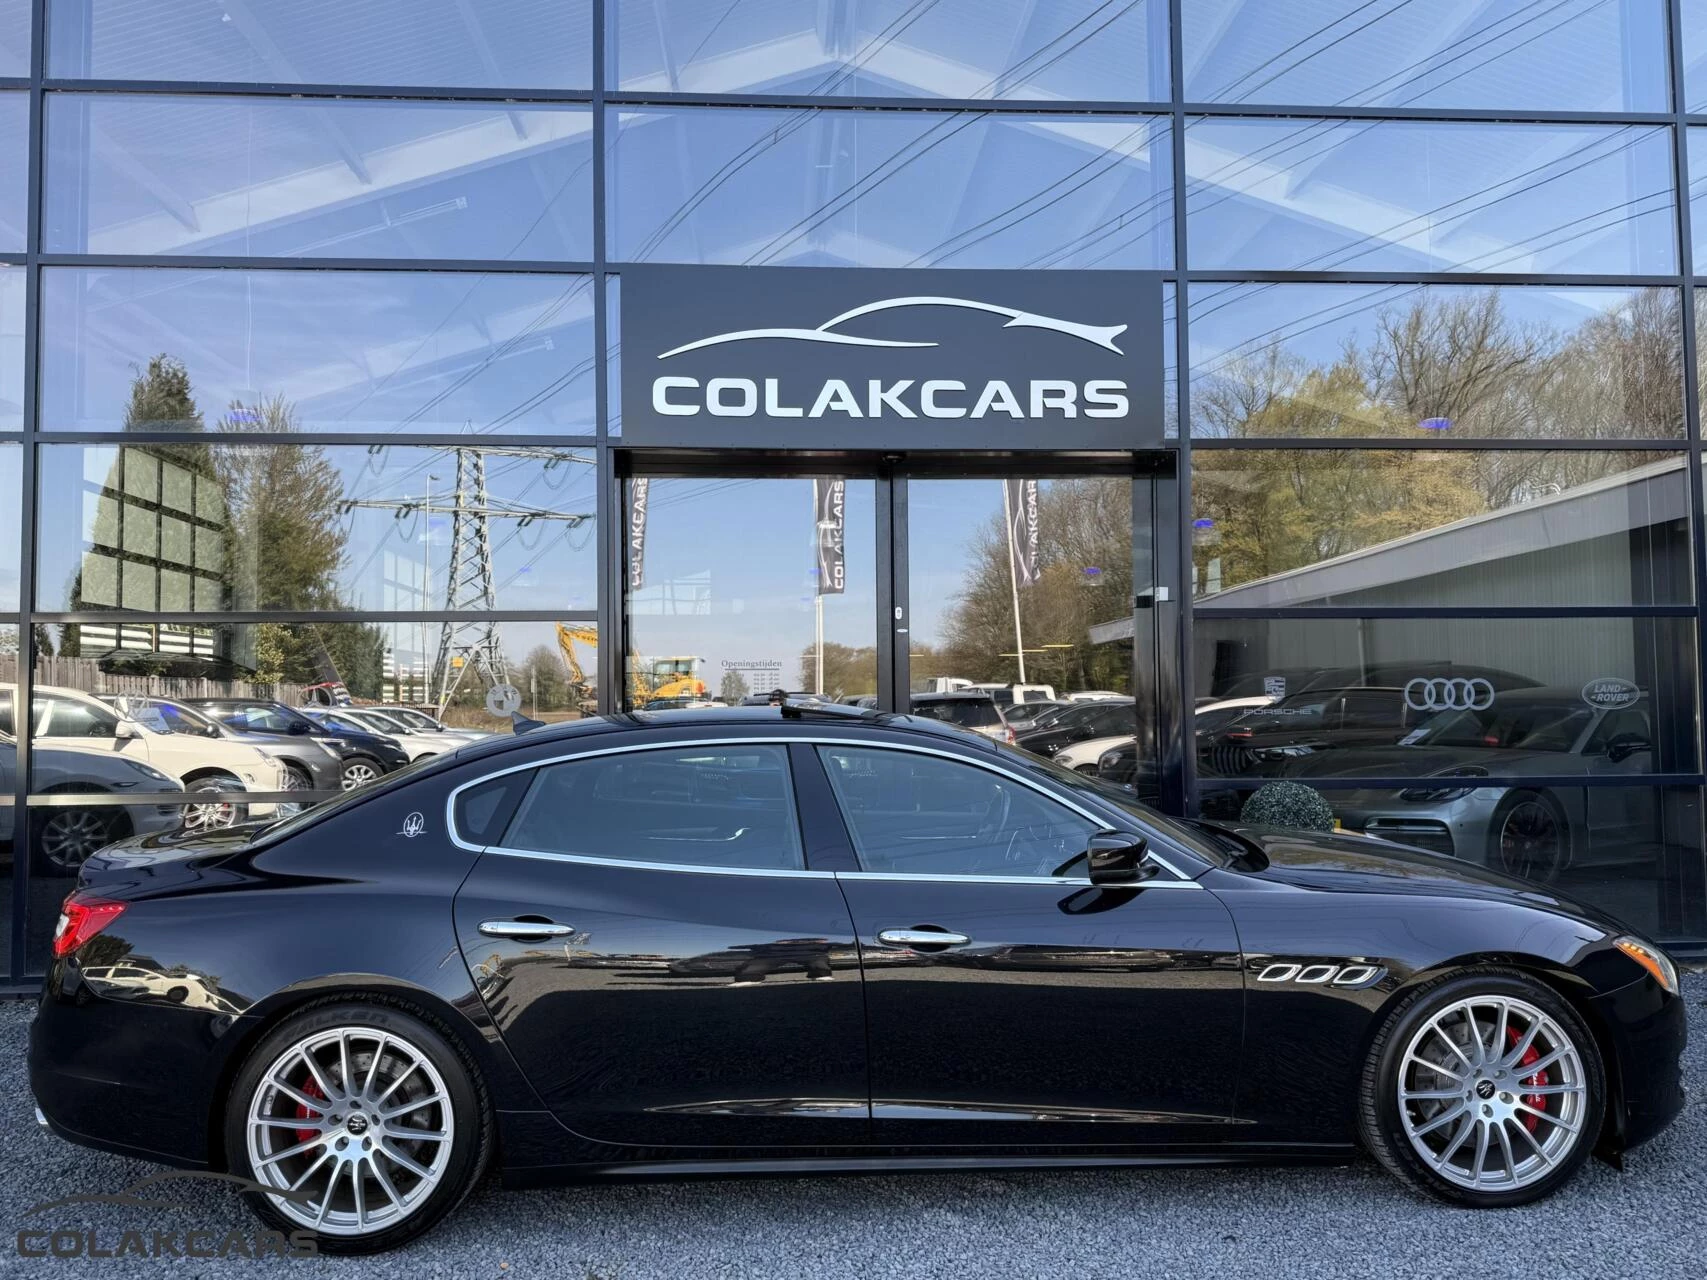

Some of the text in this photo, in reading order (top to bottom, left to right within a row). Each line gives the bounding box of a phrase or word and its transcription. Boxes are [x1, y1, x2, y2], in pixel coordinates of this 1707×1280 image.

[652, 376, 1130, 419] COLAKCARS
[833, 481, 844, 589] COLAKCARS
[721, 659, 782, 668] Openingstijden
[1594, 684, 1621, 693] LAND
[1596, 693, 1630, 702] ROVER
